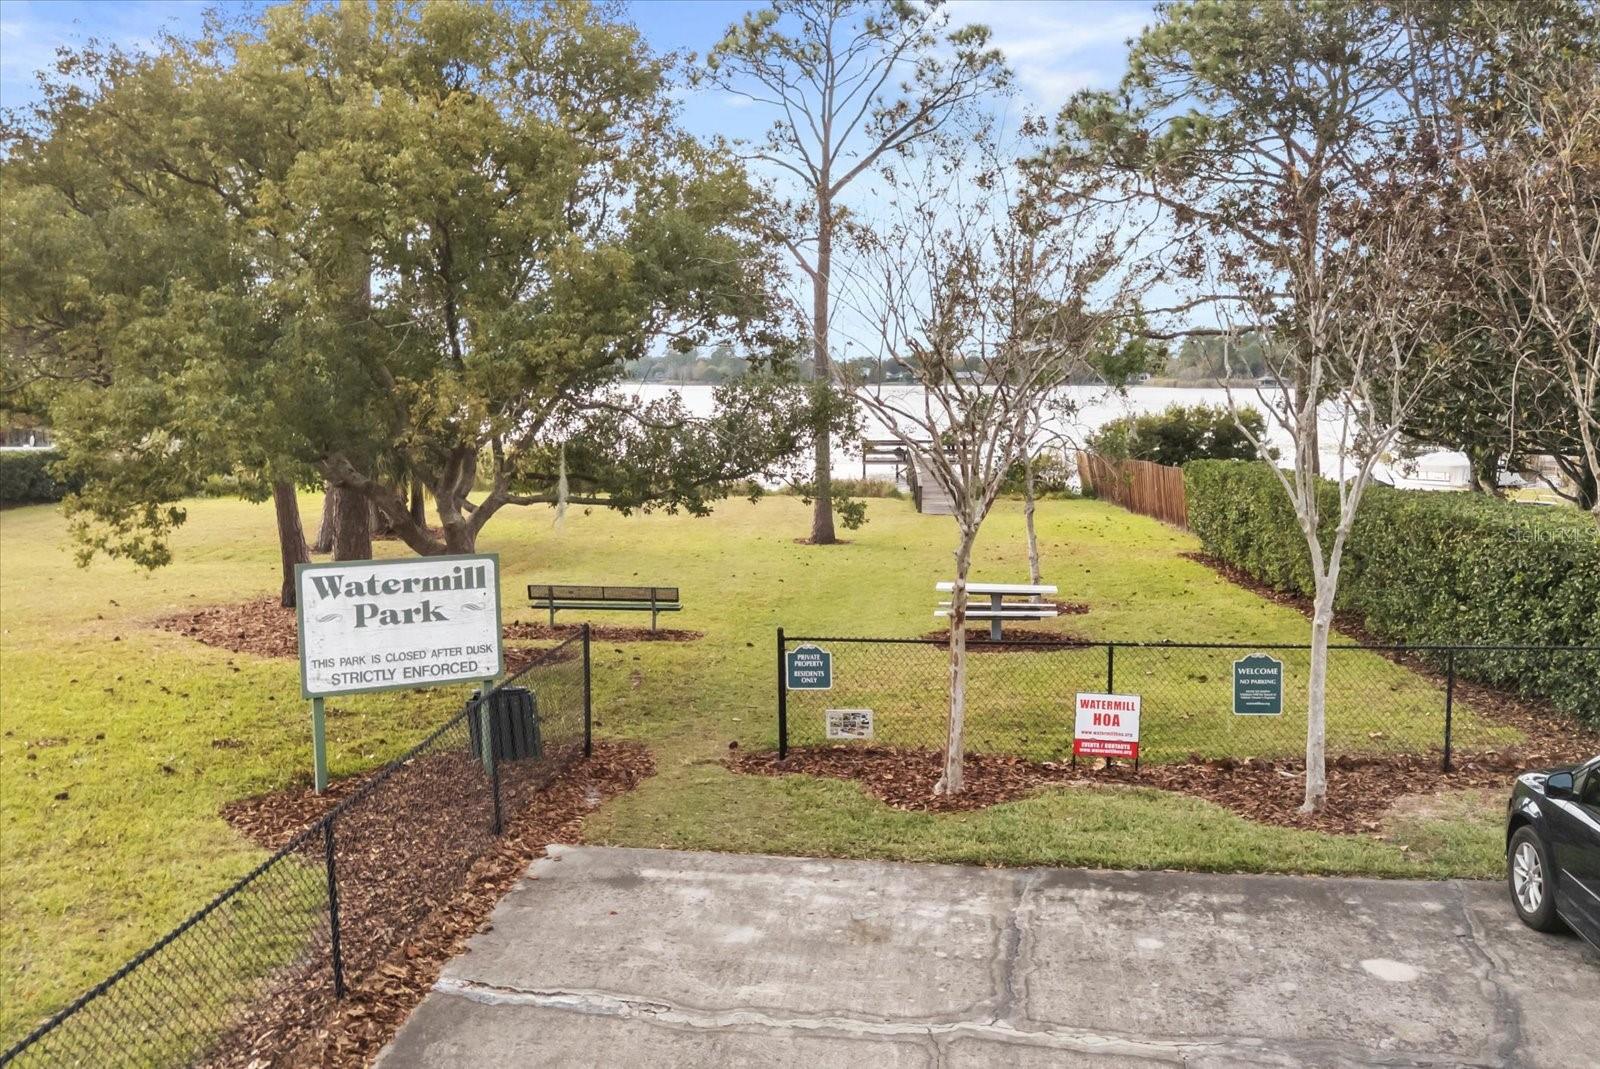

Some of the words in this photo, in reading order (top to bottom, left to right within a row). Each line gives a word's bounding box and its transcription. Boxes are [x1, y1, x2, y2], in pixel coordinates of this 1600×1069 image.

[310, 565, 486, 600] Watermill
[354, 600, 449, 628] Park
[312, 658, 335, 669] THIS
[339, 655, 366, 666] PARK
[371, 654, 381, 663] IS
[385, 650, 427, 662] CLOSED
[430, 647, 462, 658] AFTER
[466, 643, 493, 654] DUSK
[331, 668, 397, 686] STRICTLY
[402, 660, 478, 679] ENFORCED
[1237, 667, 1279, 675] WELCOME
[1080, 699, 1136, 711] WATERMILL
[1092, 713, 1121, 727] HOA
